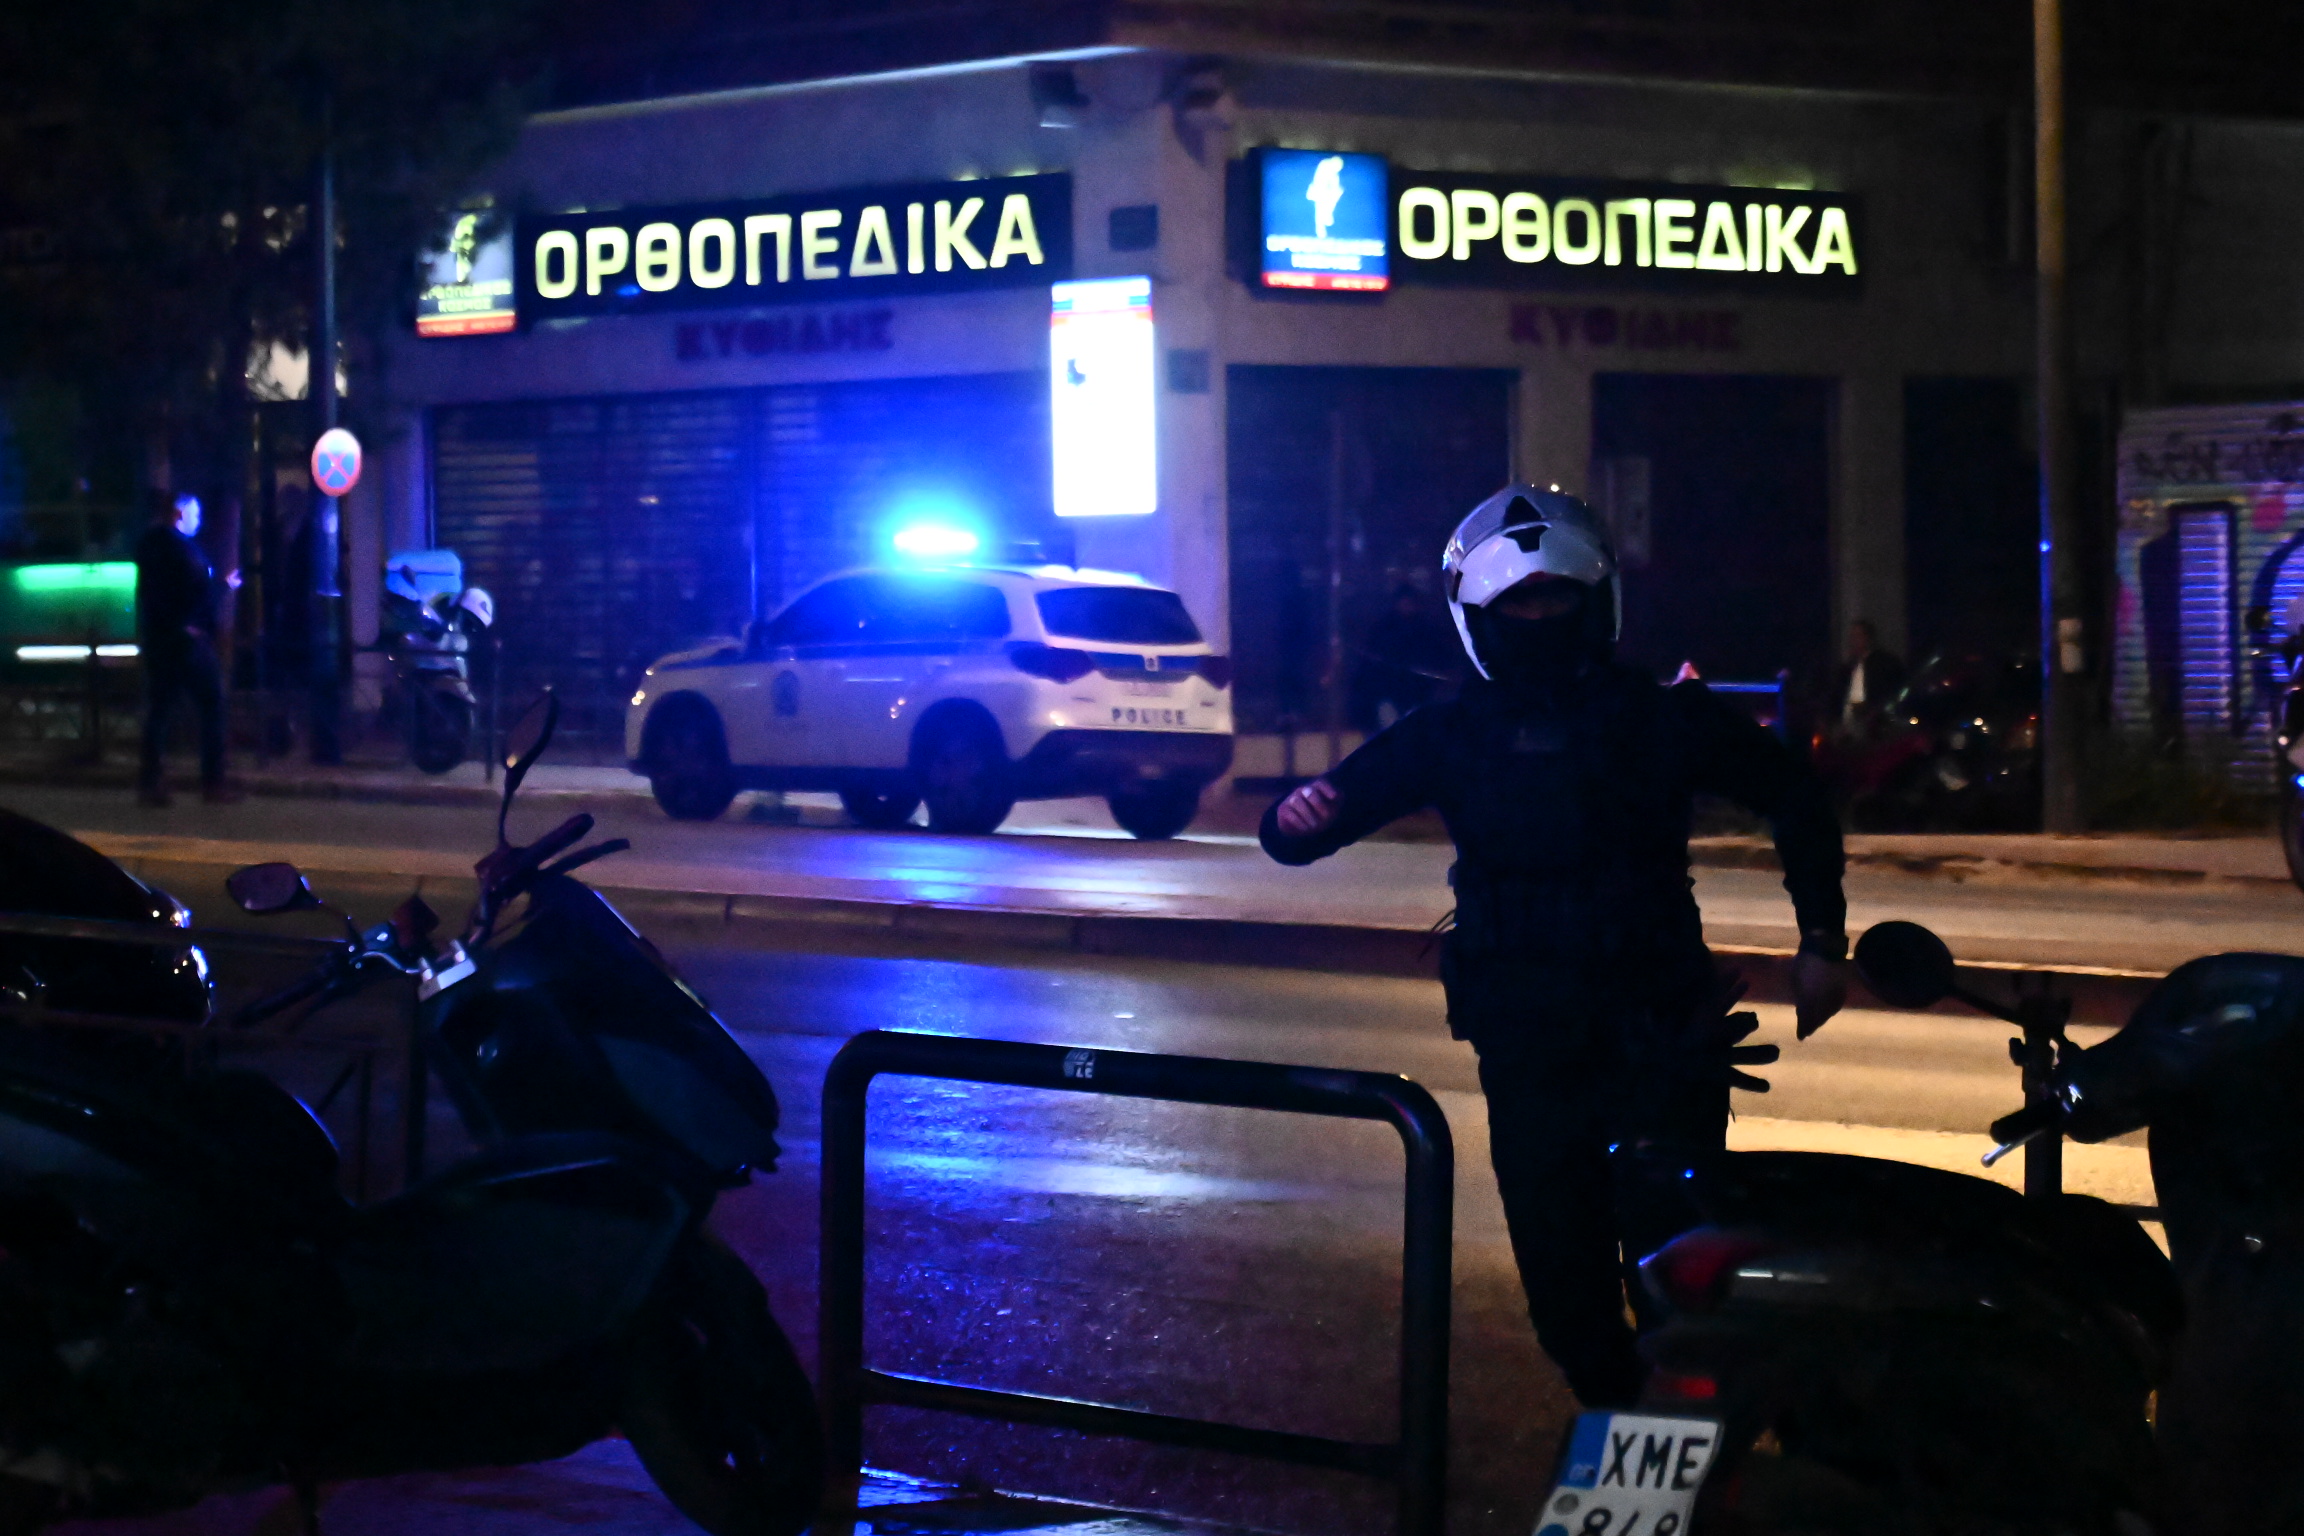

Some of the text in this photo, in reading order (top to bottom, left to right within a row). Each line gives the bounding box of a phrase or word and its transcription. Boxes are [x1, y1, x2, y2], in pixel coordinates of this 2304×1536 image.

[535, 193, 1045, 299] ΟΡΘΟΠΕΔΙΚΑ
[1398, 186, 1857, 275] ΟΡΘΟΠΕΔΙΚΑ
[1602, 1432, 1709, 1490] XME
